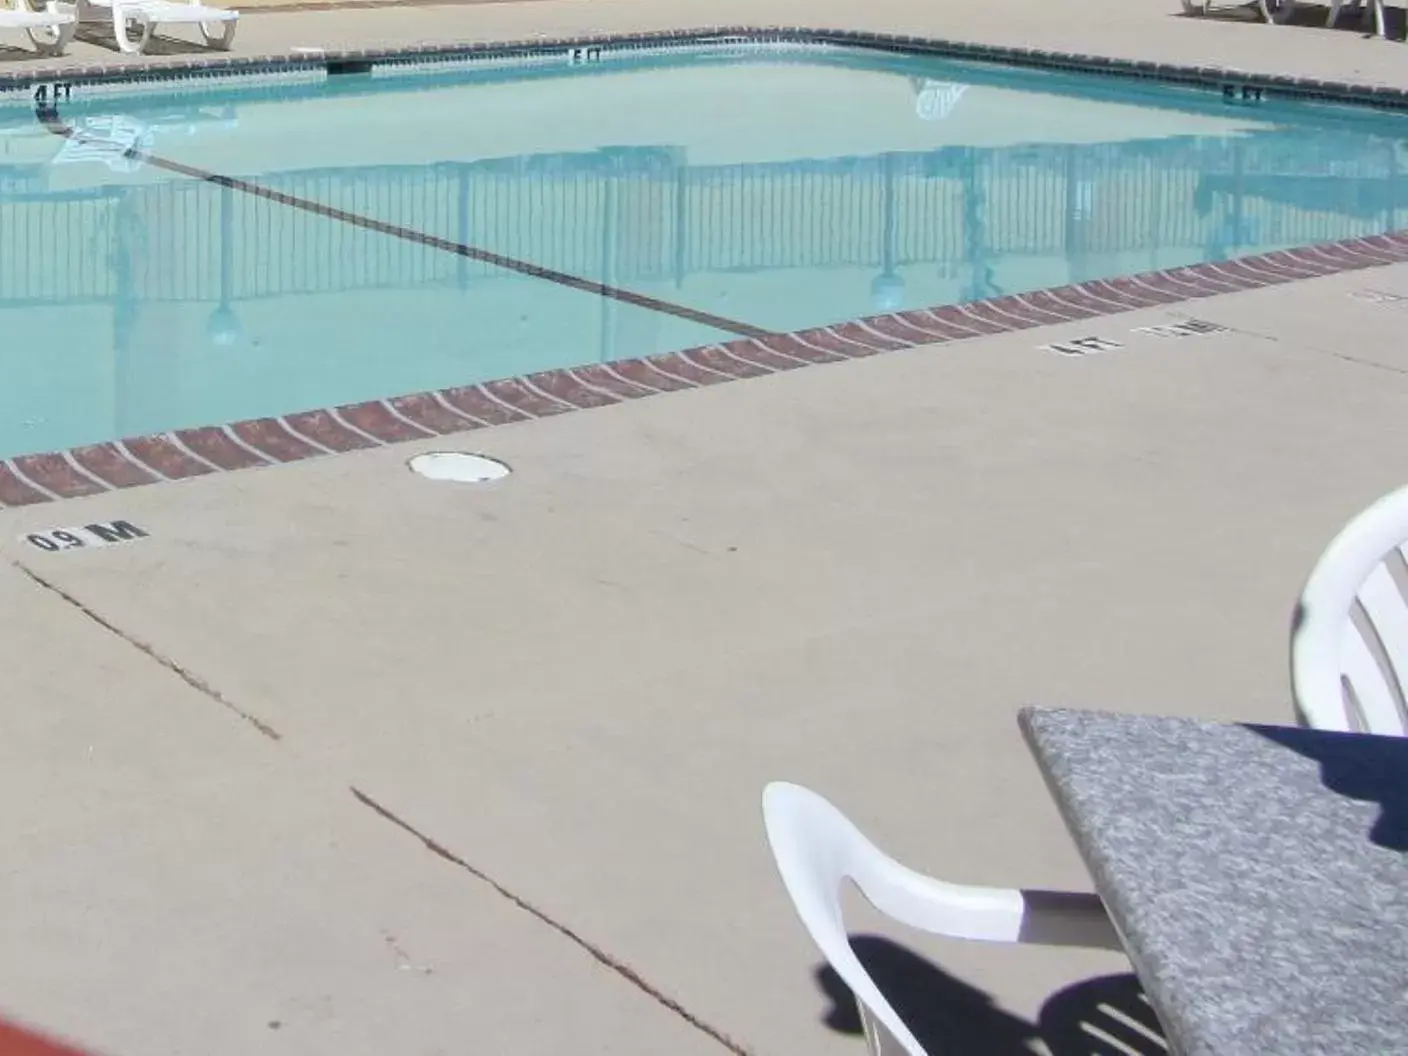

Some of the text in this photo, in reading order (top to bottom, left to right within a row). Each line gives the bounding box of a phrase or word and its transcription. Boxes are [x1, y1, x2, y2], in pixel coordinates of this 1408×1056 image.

[33, 82, 72, 102] 4 FT
[83, 520, 150, 543] M
